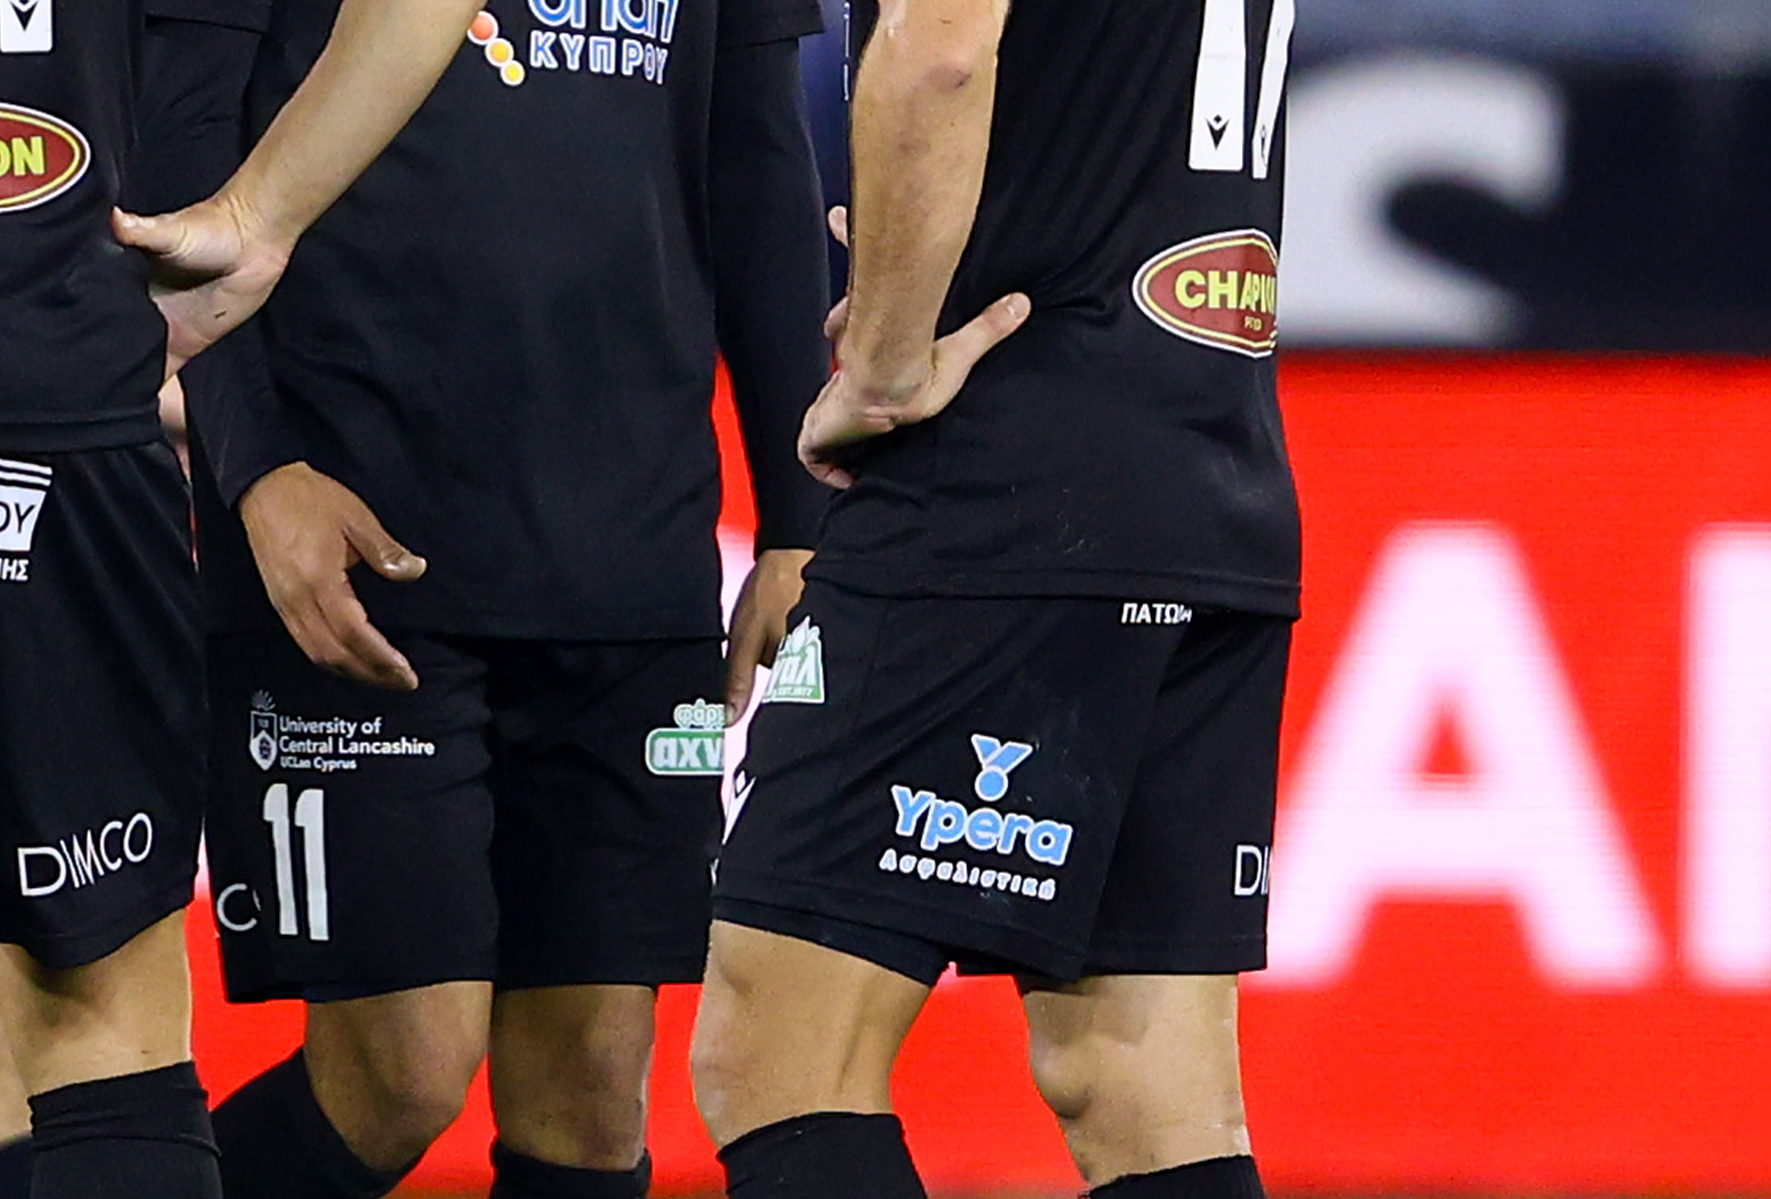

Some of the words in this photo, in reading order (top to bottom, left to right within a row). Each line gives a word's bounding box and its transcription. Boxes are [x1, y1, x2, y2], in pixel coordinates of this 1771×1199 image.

[529, 30, 668, 84] ΚΥΠΡΟΥ
[279, 716, 357, 738] University
[360, 716, 382, 734] of
[279, 736, 333, 753] Central
[338, 736, 435, 756] Lancashire
[280, 756, 311, 768] UCLan
[313, 756, 357, 772] Cyprus
[890, 784, 1073, 867] Ypera
[17, 812, 153, 896] DIMCO
[263, 783, 329, 940] 11
